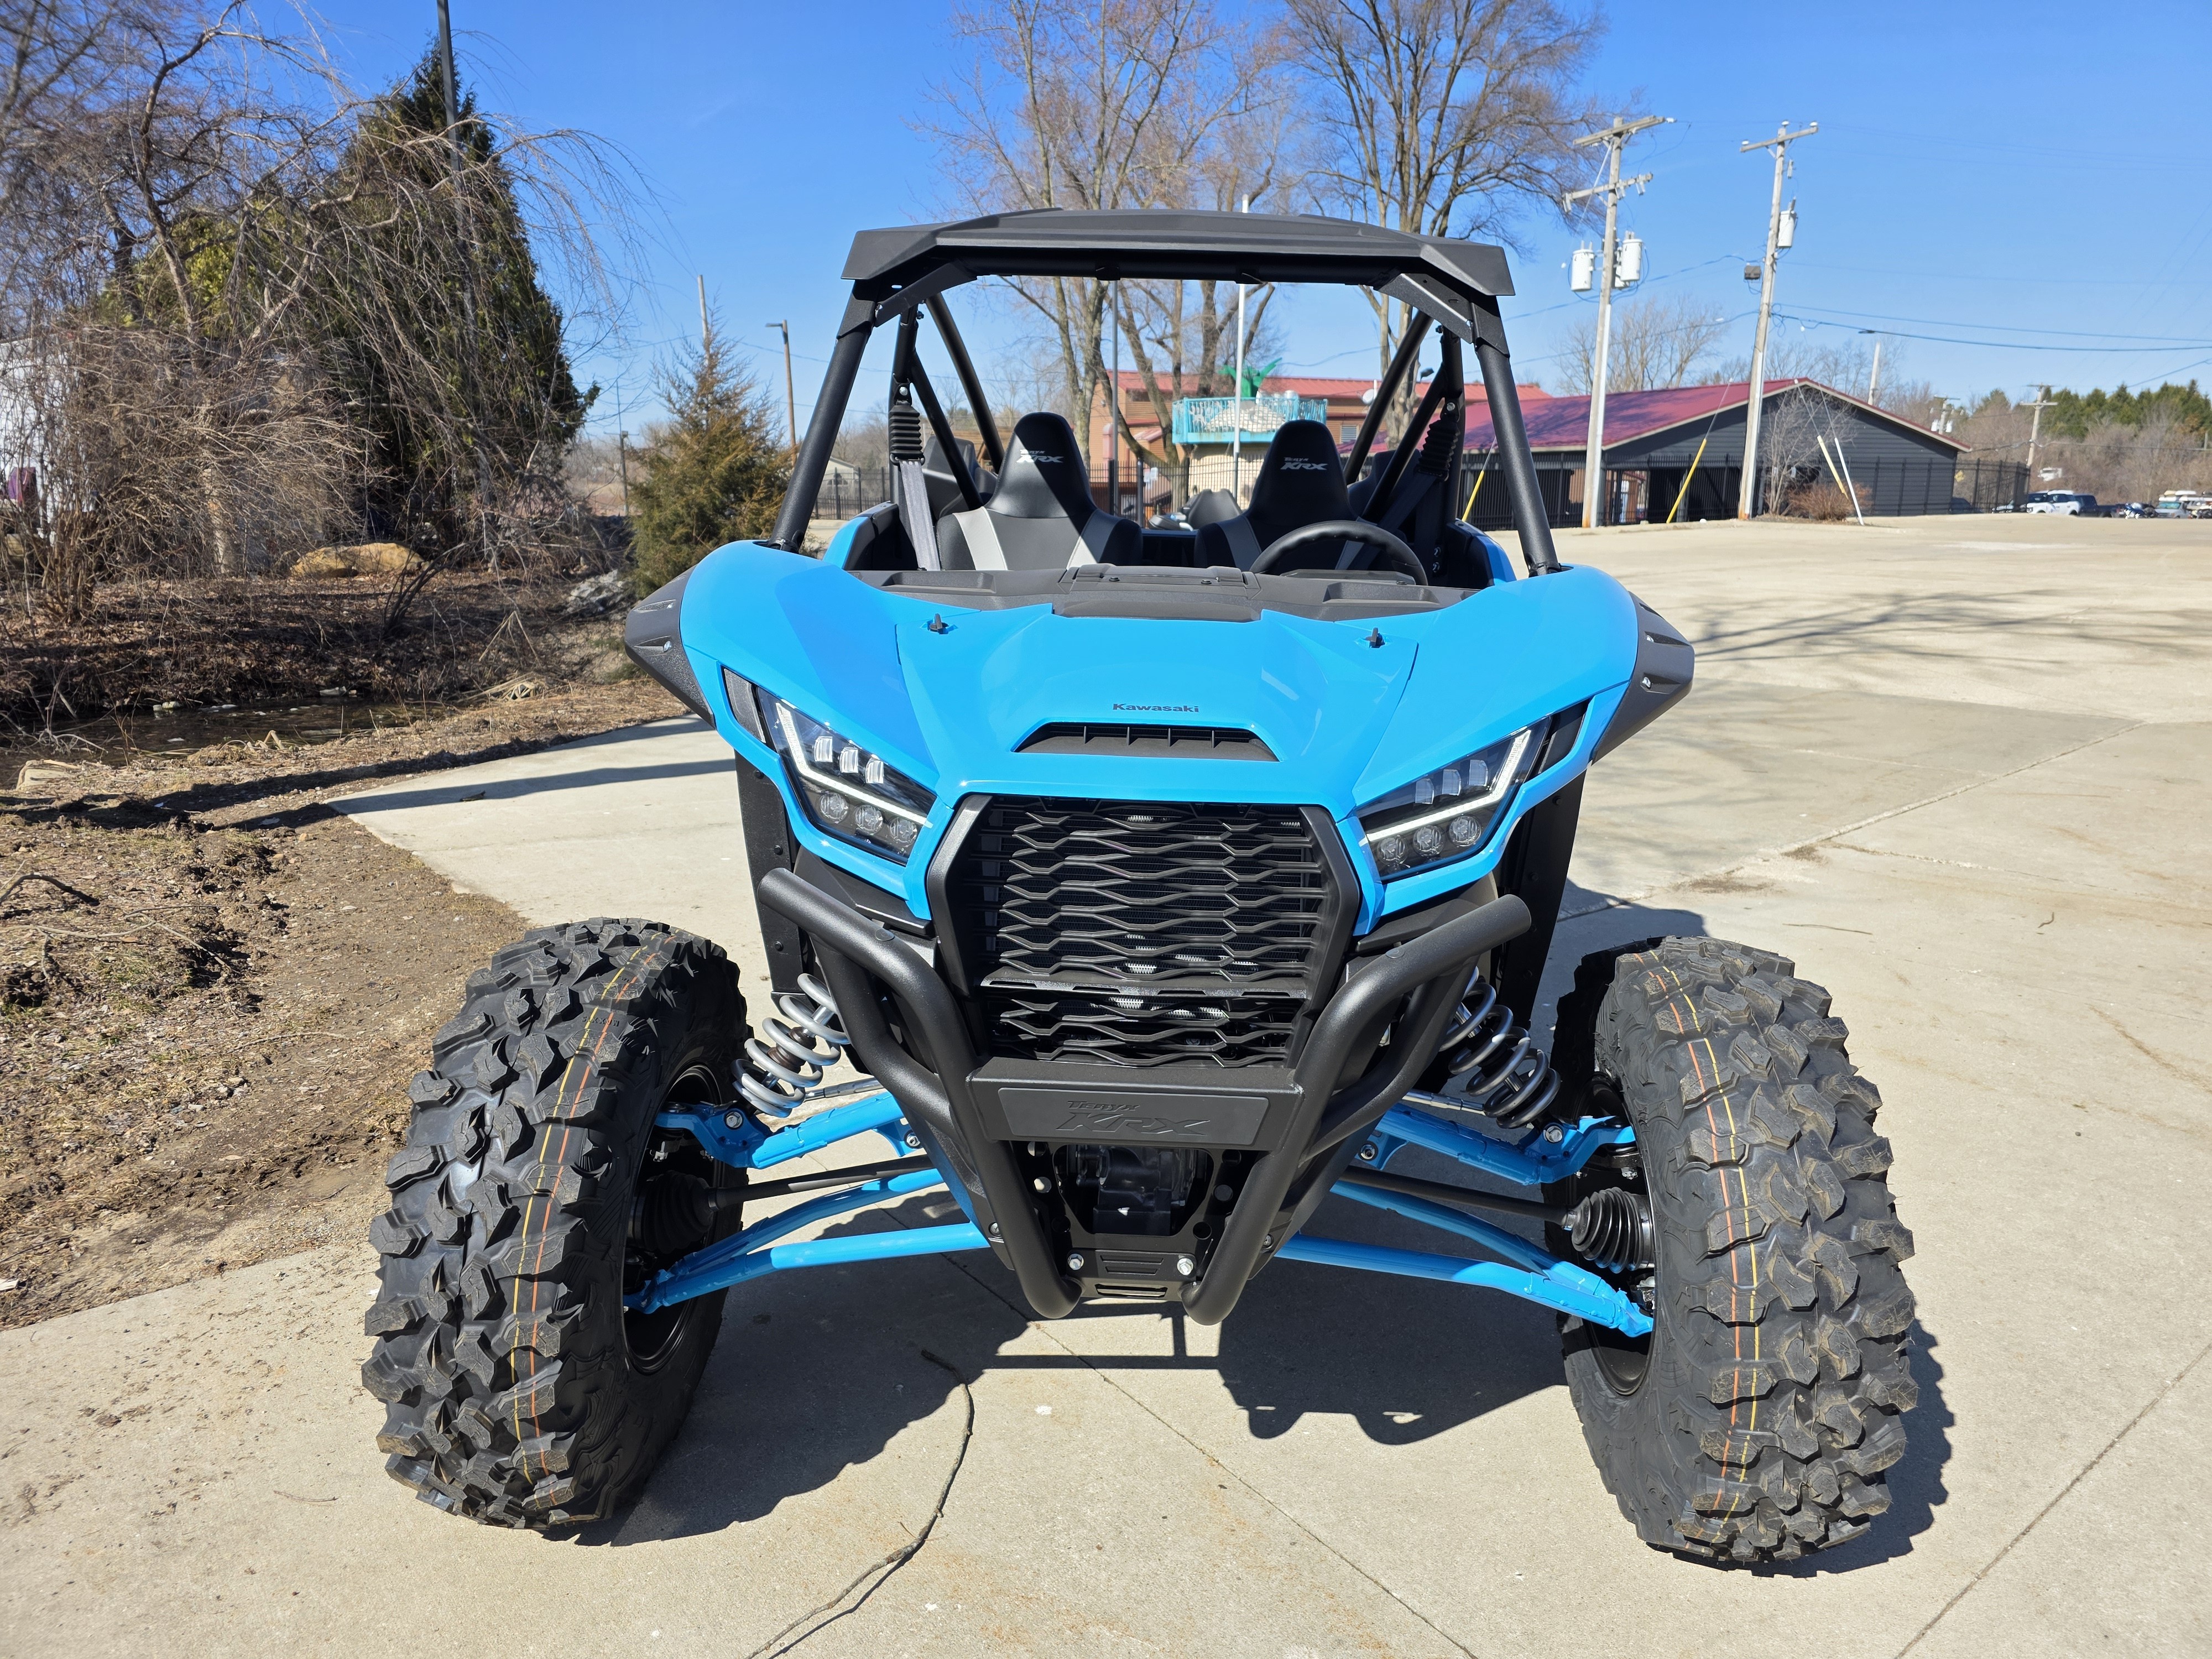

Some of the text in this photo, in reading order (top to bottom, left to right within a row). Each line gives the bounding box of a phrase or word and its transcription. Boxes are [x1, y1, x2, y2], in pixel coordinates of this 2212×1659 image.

[1280, 462, 1328, 470] KRX
[1113, 703, 1199, 713] Kawasaki
[1055, 1112, 1211, 1136] KRX
